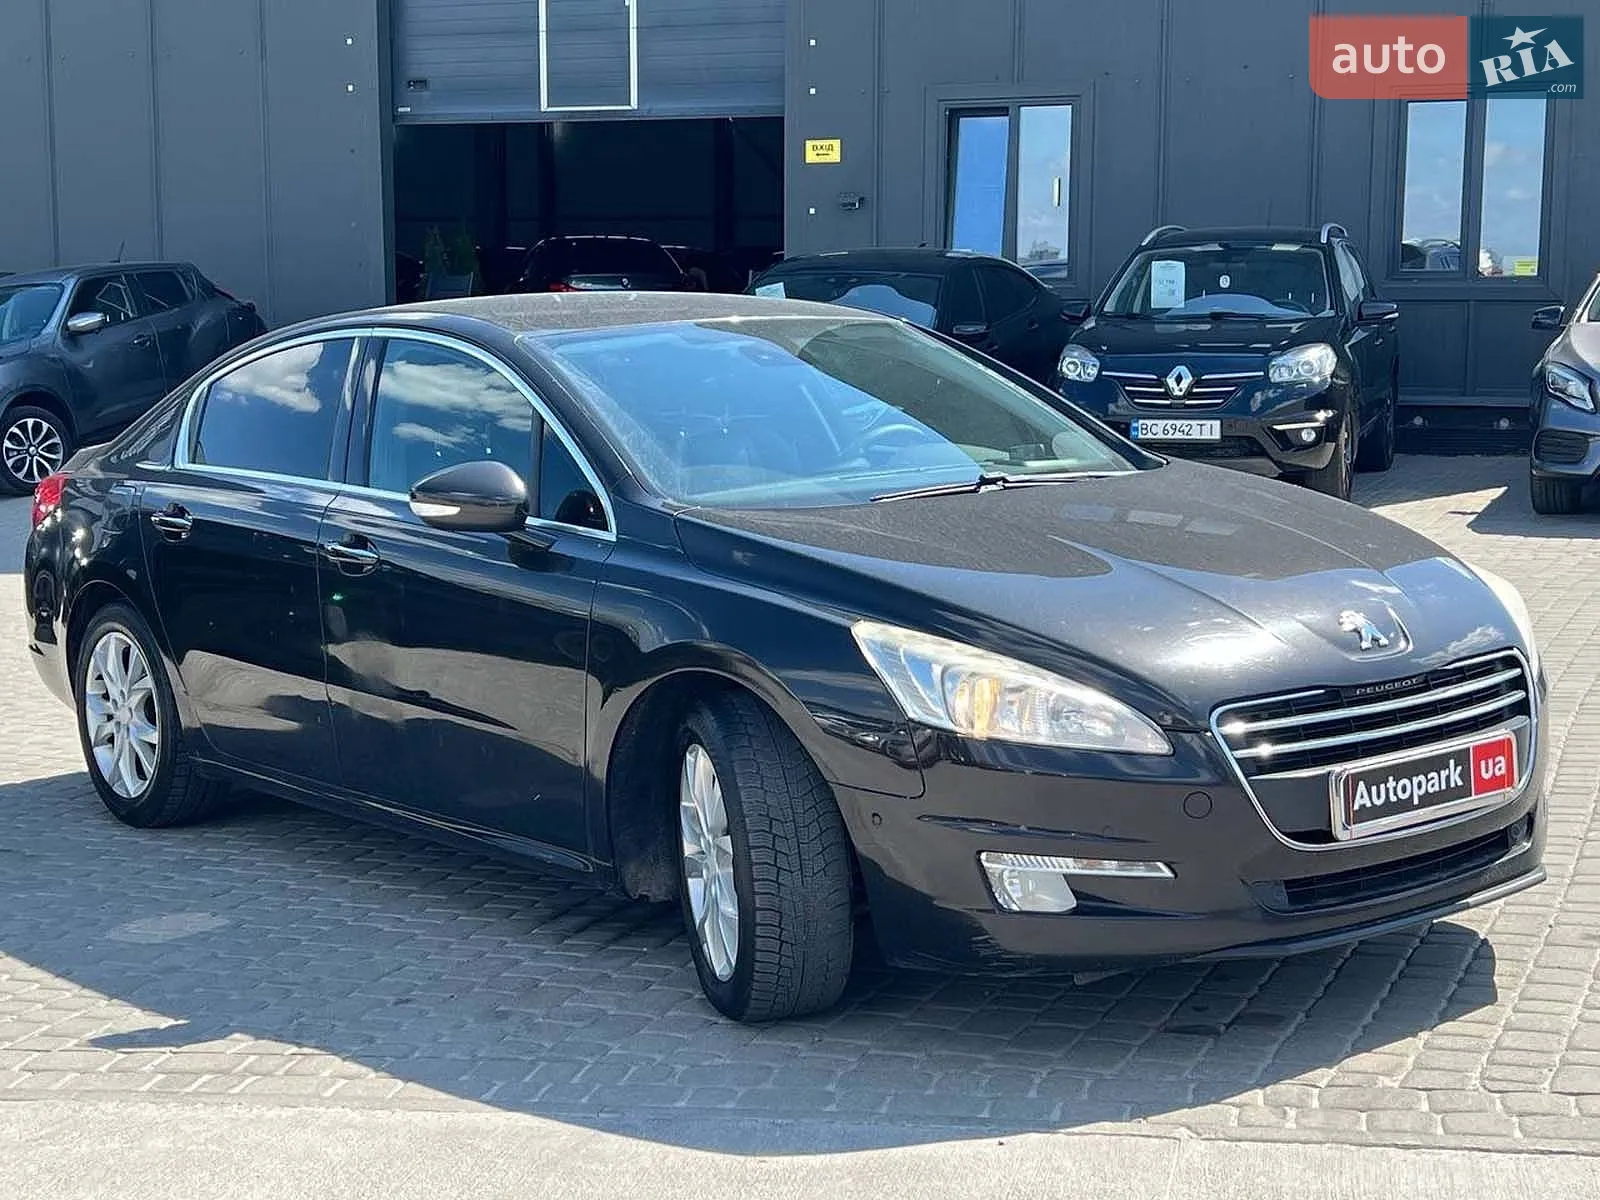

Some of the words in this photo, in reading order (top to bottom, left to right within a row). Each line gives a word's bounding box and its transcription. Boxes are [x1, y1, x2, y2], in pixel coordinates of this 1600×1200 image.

[1140, 423, 1159, 436] BC
[1162, 422, 1193, 436] 6942
[1356, 677, 1418, 695] PEUGEOT
[1353, 759, 1464, 811] Autopark
[1480, 755, 1507, 779] ua
